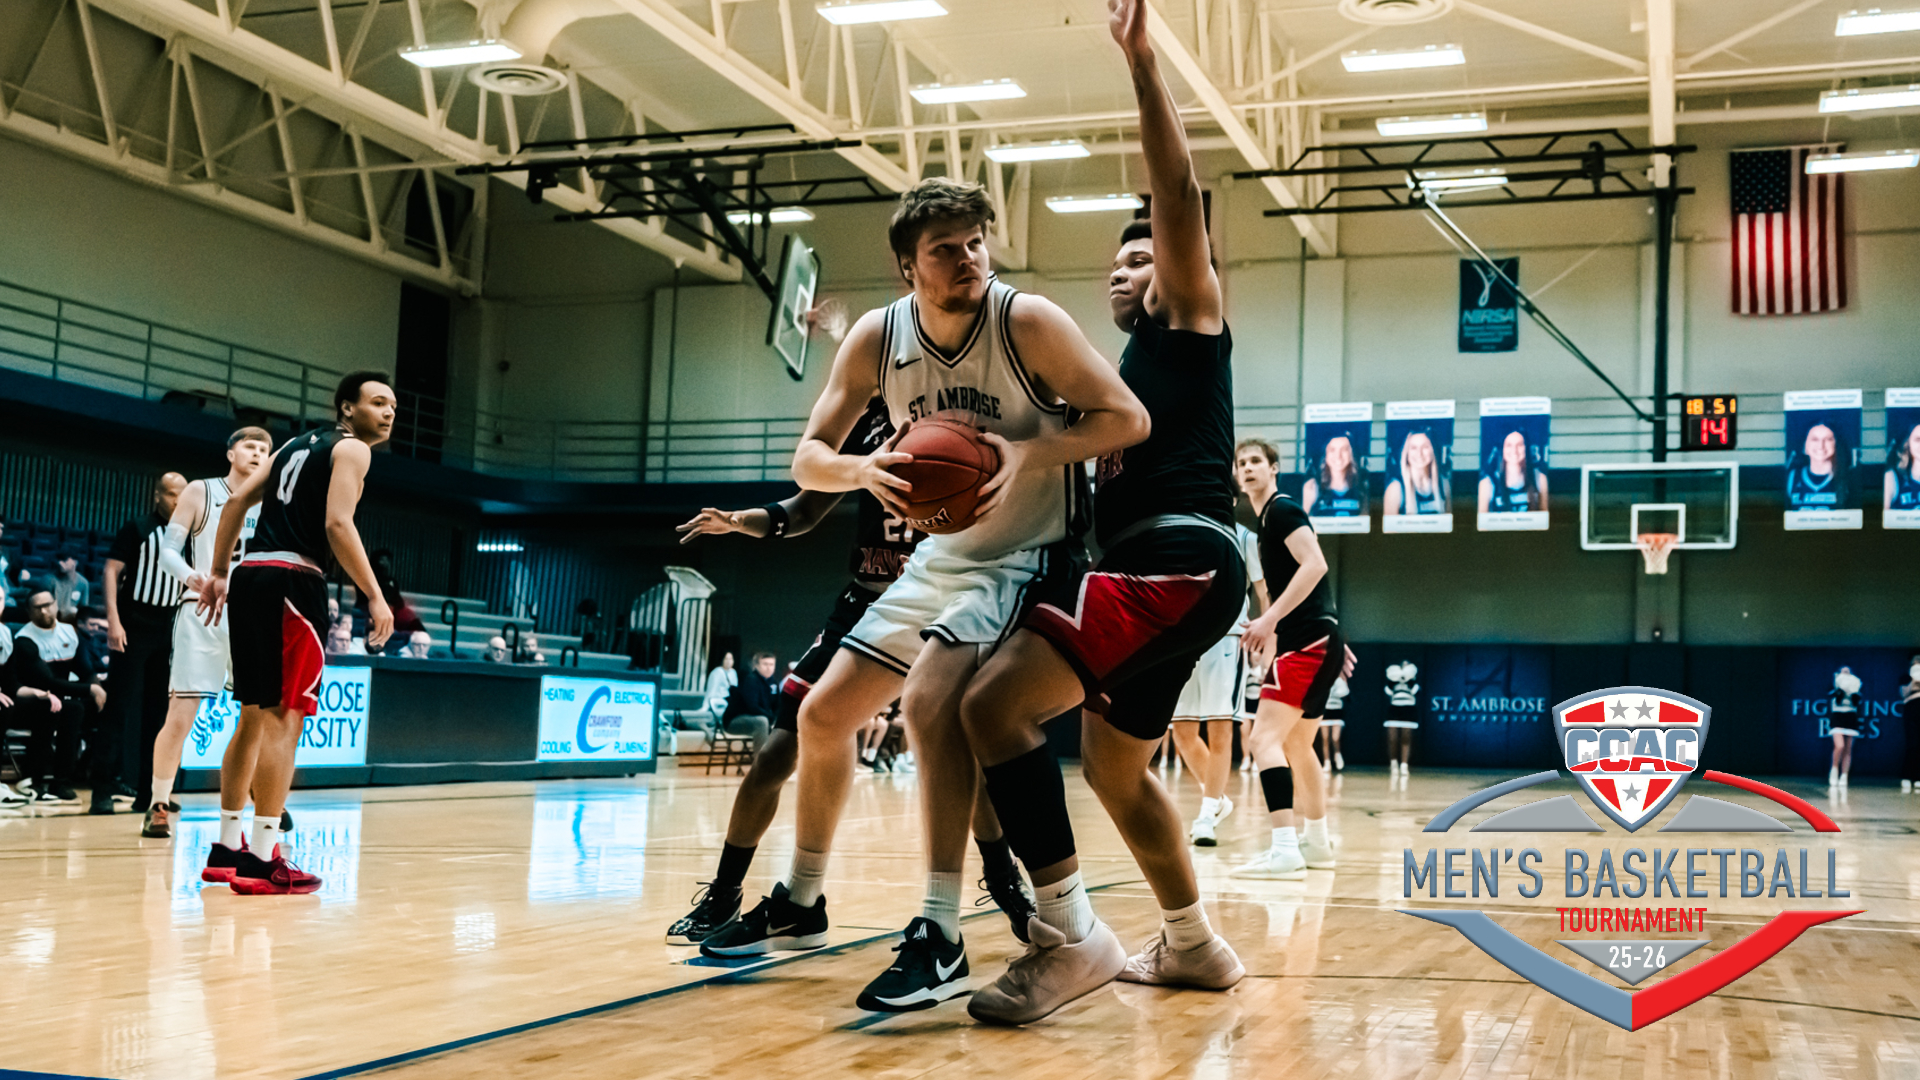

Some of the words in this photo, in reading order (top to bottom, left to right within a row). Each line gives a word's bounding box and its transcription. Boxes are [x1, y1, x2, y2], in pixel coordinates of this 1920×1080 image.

[908, 394, 932, 423] ST.
[937, 386, 1002, 420] AMBROSE
[1700, 417, 1728, 445] 14
[277, 448, 311, 506] 0
[318, 681, 365, 712] ROSE
[1431, 696, 1453, 711] ST.
[1458, 696, 1545, 712] AMBROSE
[299, 717, 361, 748] RSITY
[541, 741, 571, 754] COOLING
